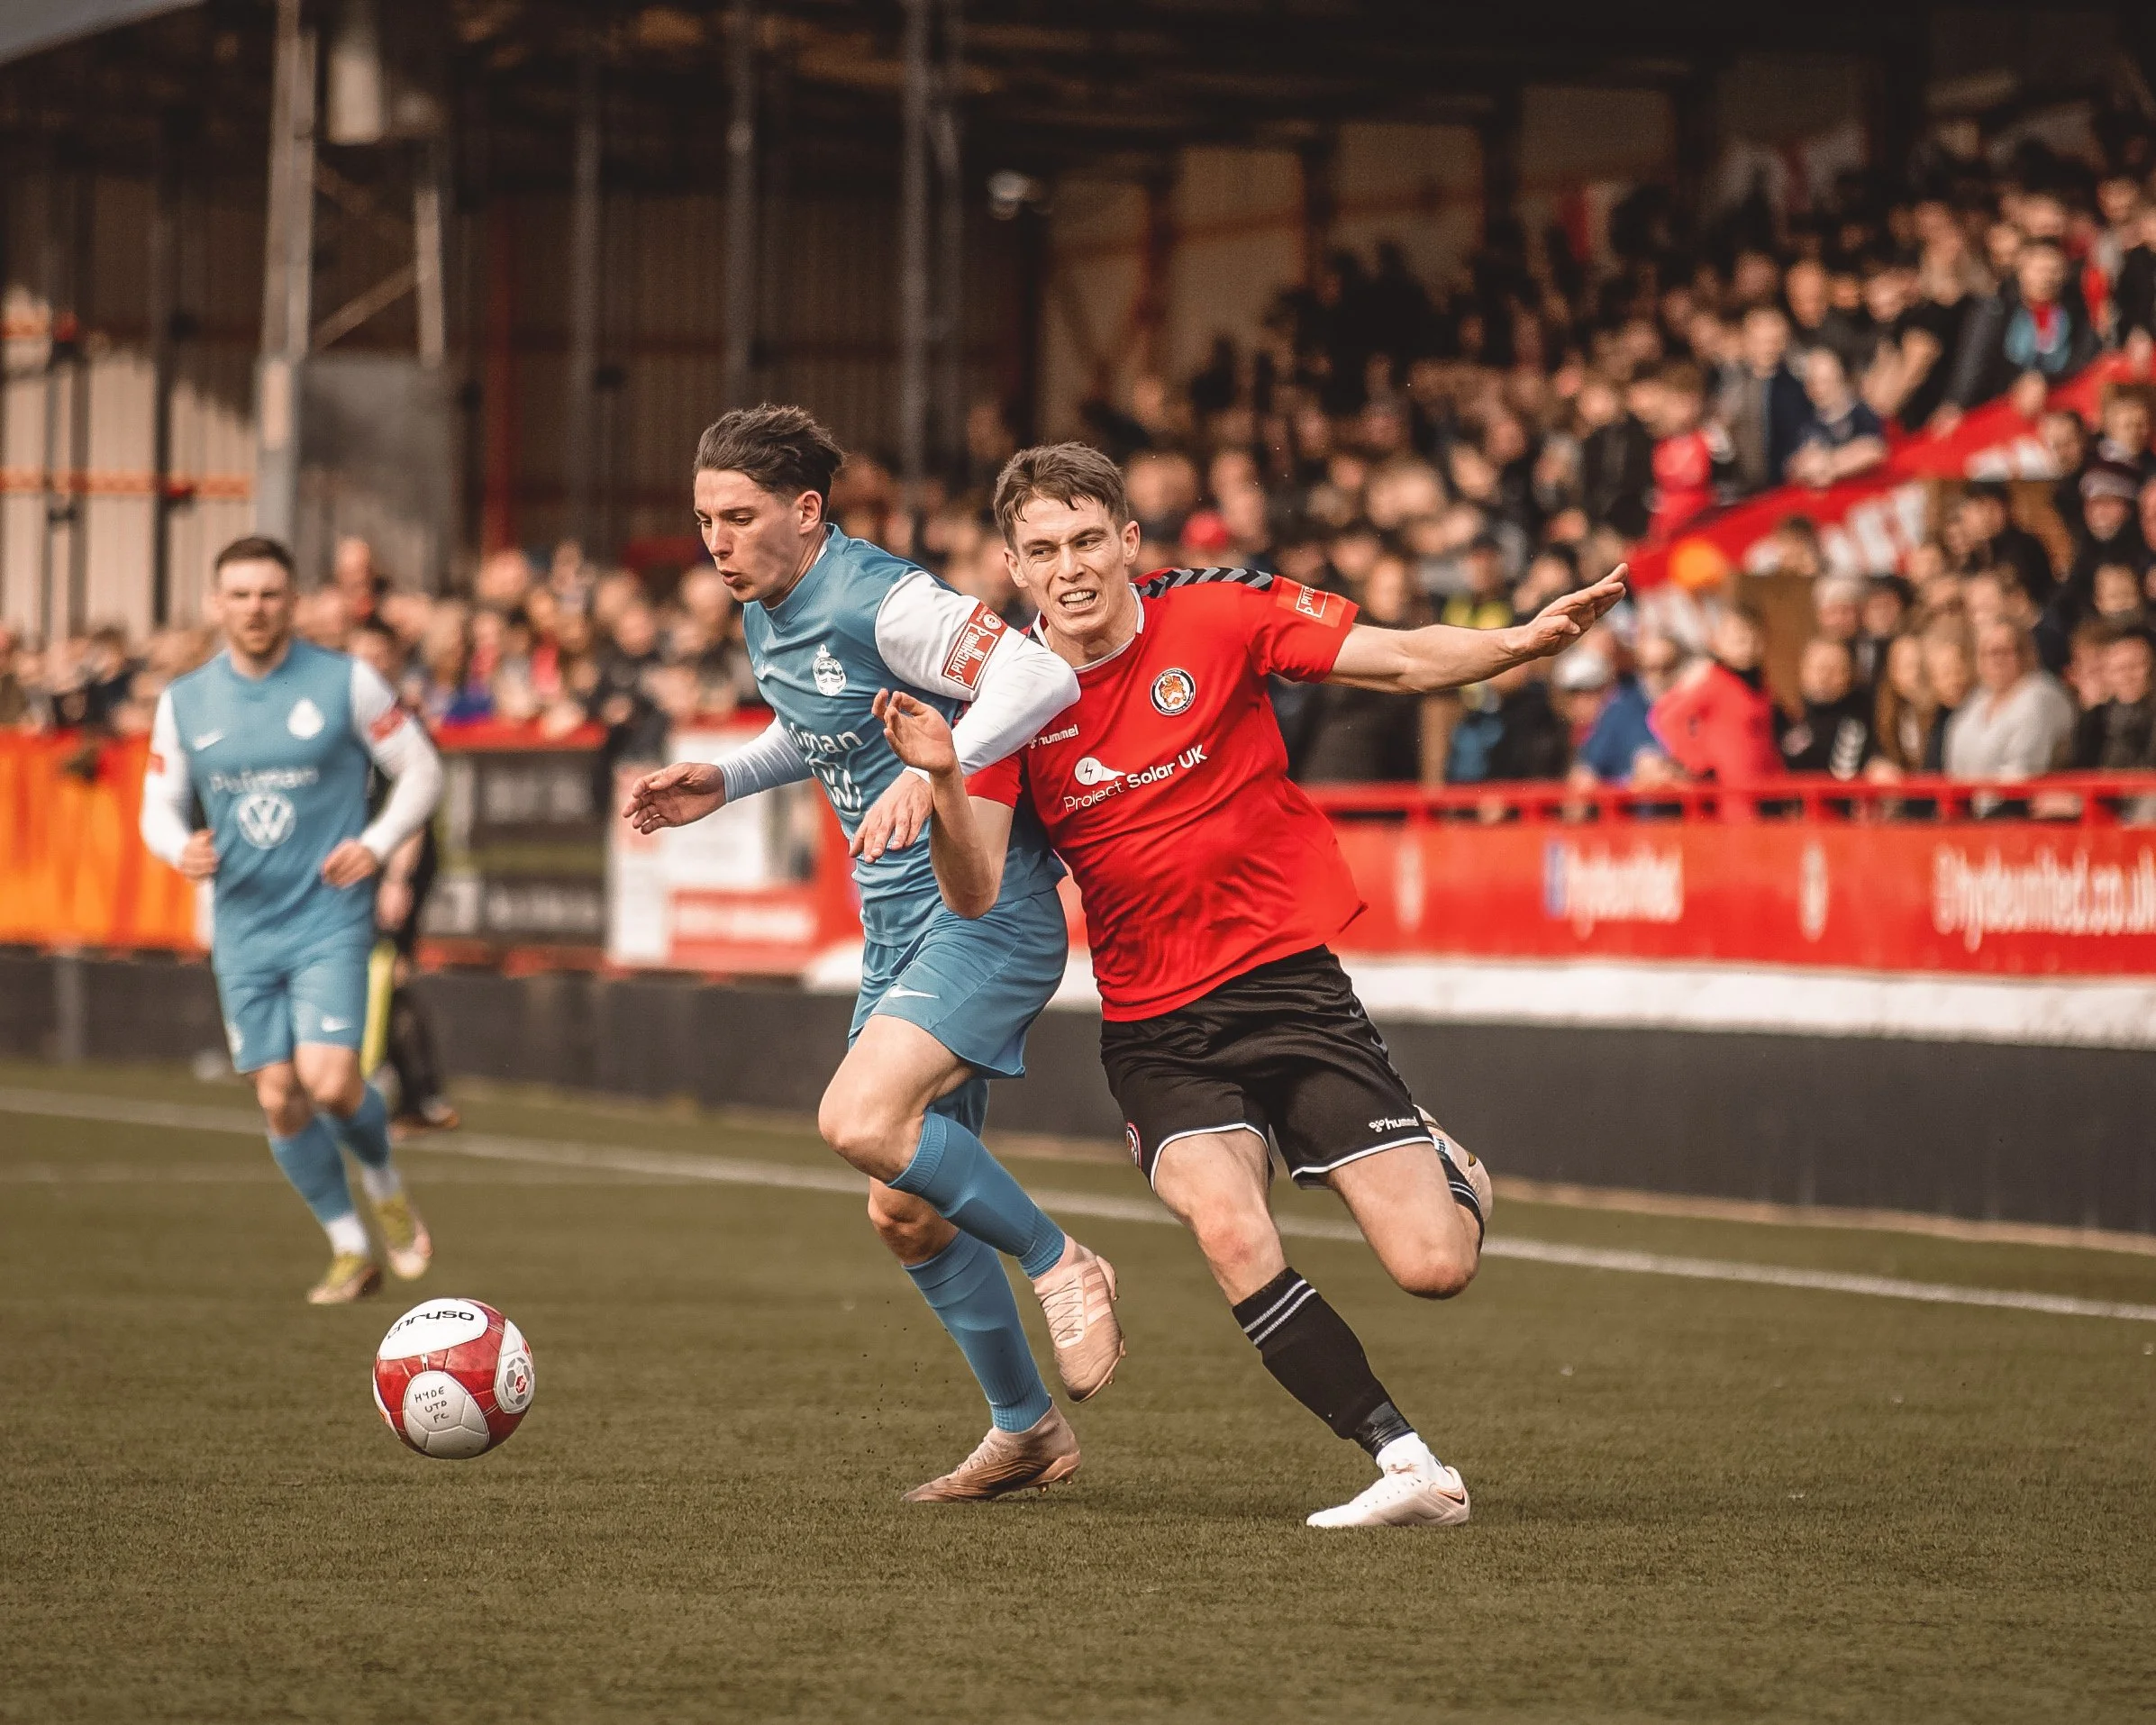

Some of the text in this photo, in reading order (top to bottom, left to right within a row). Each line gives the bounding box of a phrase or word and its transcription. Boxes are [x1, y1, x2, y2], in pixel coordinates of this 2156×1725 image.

[951, 631, 980, 675] PITCHING
[1063, 744, 1208, 813] Project Solar UK
[414, 1385, 445, 1403] HYDE
[424, 1400, 448, 1413] UTD
[433, 1412, 450, 1423] FC
